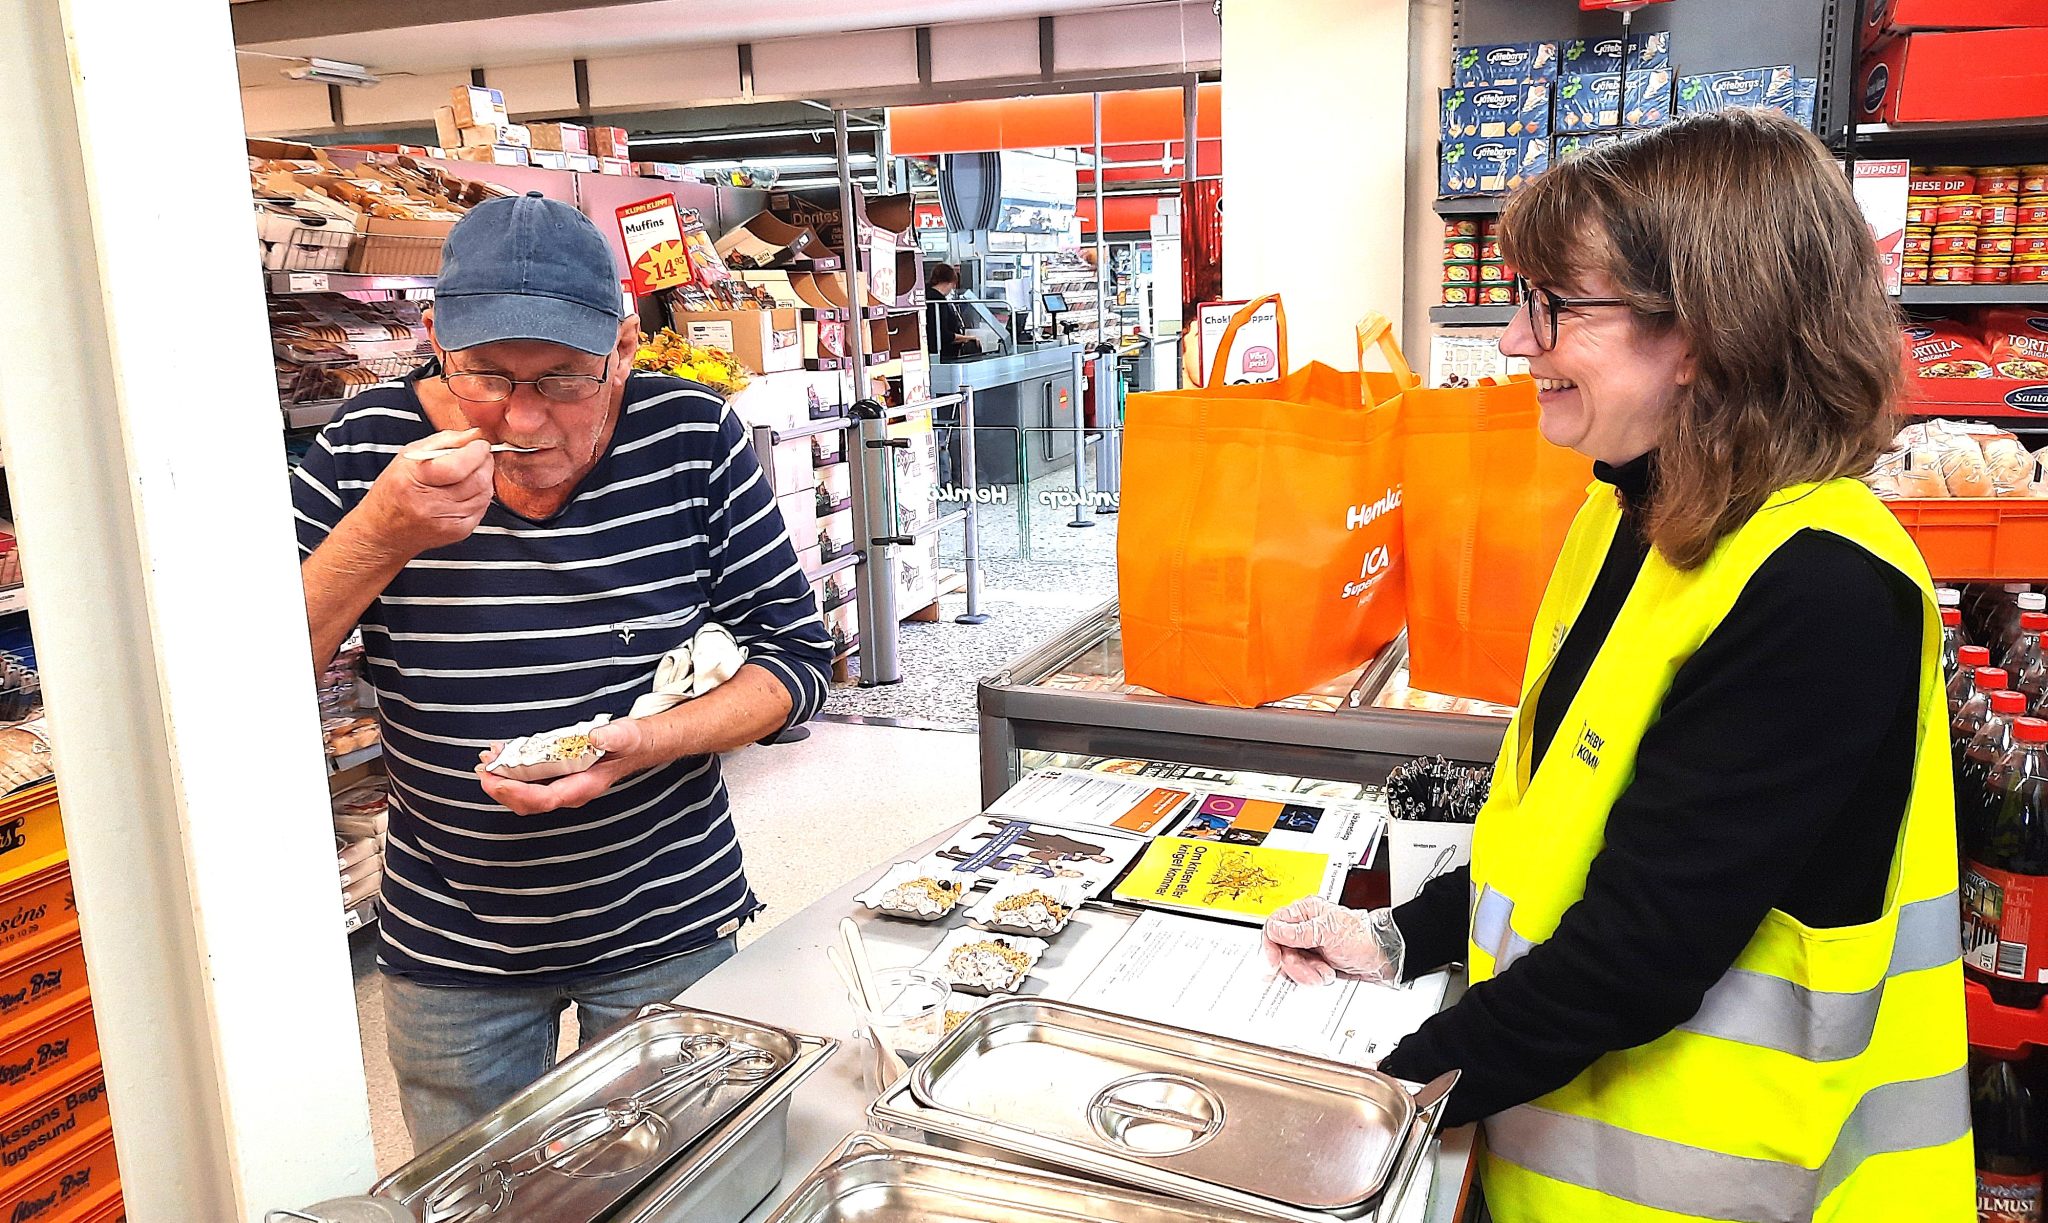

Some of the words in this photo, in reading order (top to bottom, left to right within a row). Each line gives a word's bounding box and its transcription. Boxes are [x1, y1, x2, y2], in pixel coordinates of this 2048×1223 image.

[1486, 47, 1528, 66] Göteborgs
[1711, 76, 1759, 96] Göteborgs
[1473, 89, 1517, 109] Göteborgs
[1472, 143, 1517, 162] Göteborgs
[1944, 181, 1965, 191] DIP
[625, 219, 665, 235] Muffins
[792, 210, 840, 226] Doritos
[652, 259, 678, 281] 14
[1919, 352, 1952, 363] ORIGINAL
[1360, 544, 1389, 579] ICA
[1584, 728, 1605, 752] HEBY
[1190, 846, 1208, 861] Om
[1154, 867, 1182, 896] kommer
[1180, 861, 1201, 884] krisen
[1, 1113, 77, 1167] Iggesund
